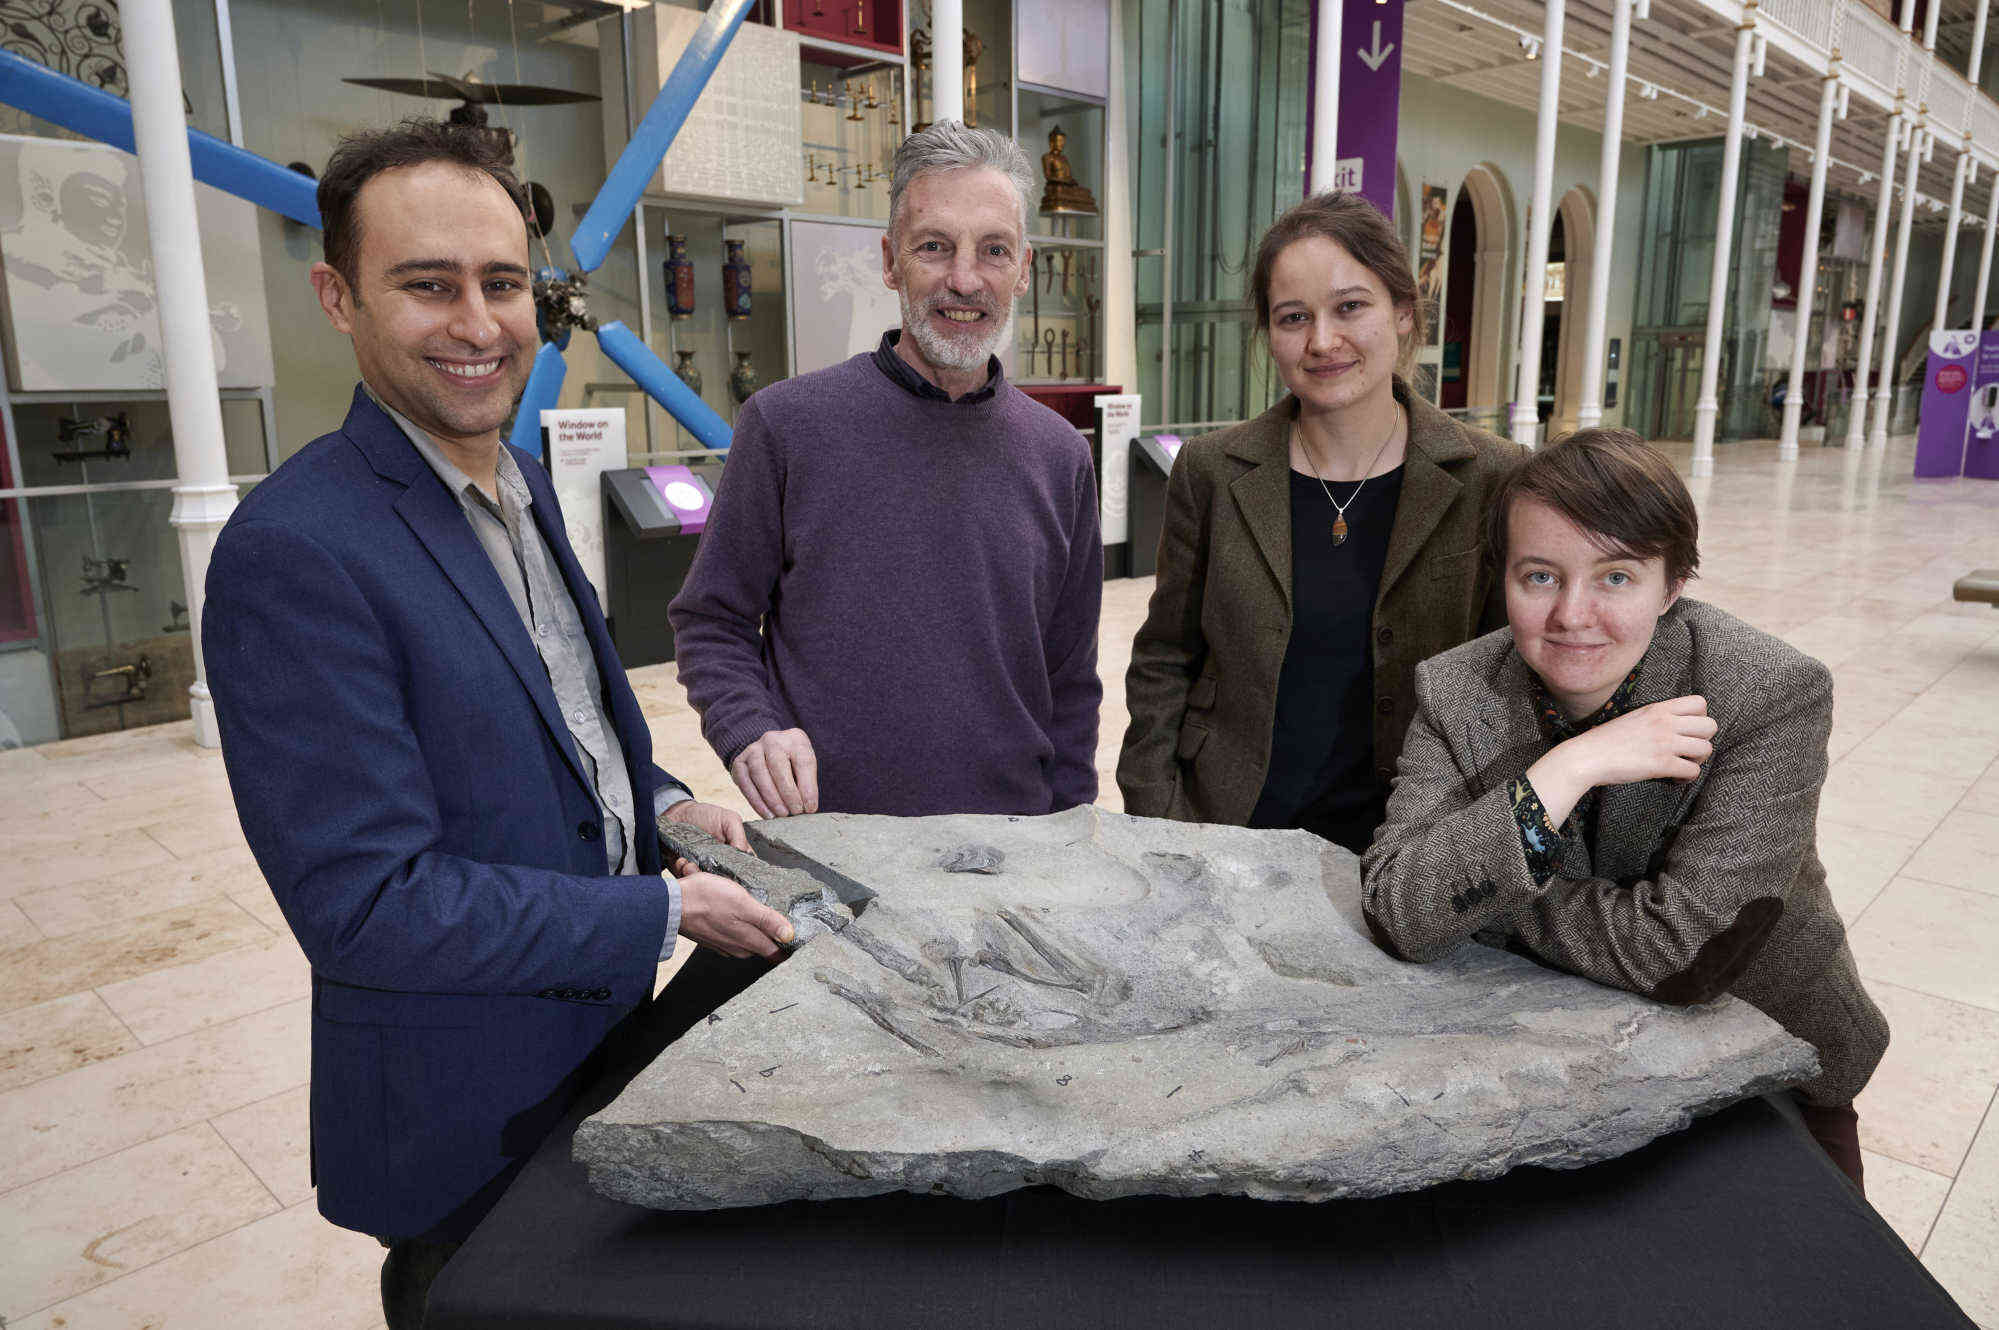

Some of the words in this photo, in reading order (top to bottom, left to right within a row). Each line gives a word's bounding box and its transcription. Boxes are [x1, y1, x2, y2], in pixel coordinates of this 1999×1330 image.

[558, 420, 595, 430] Window
[559, 433, 573, 441] the
[576, 431, 602, 441] World
